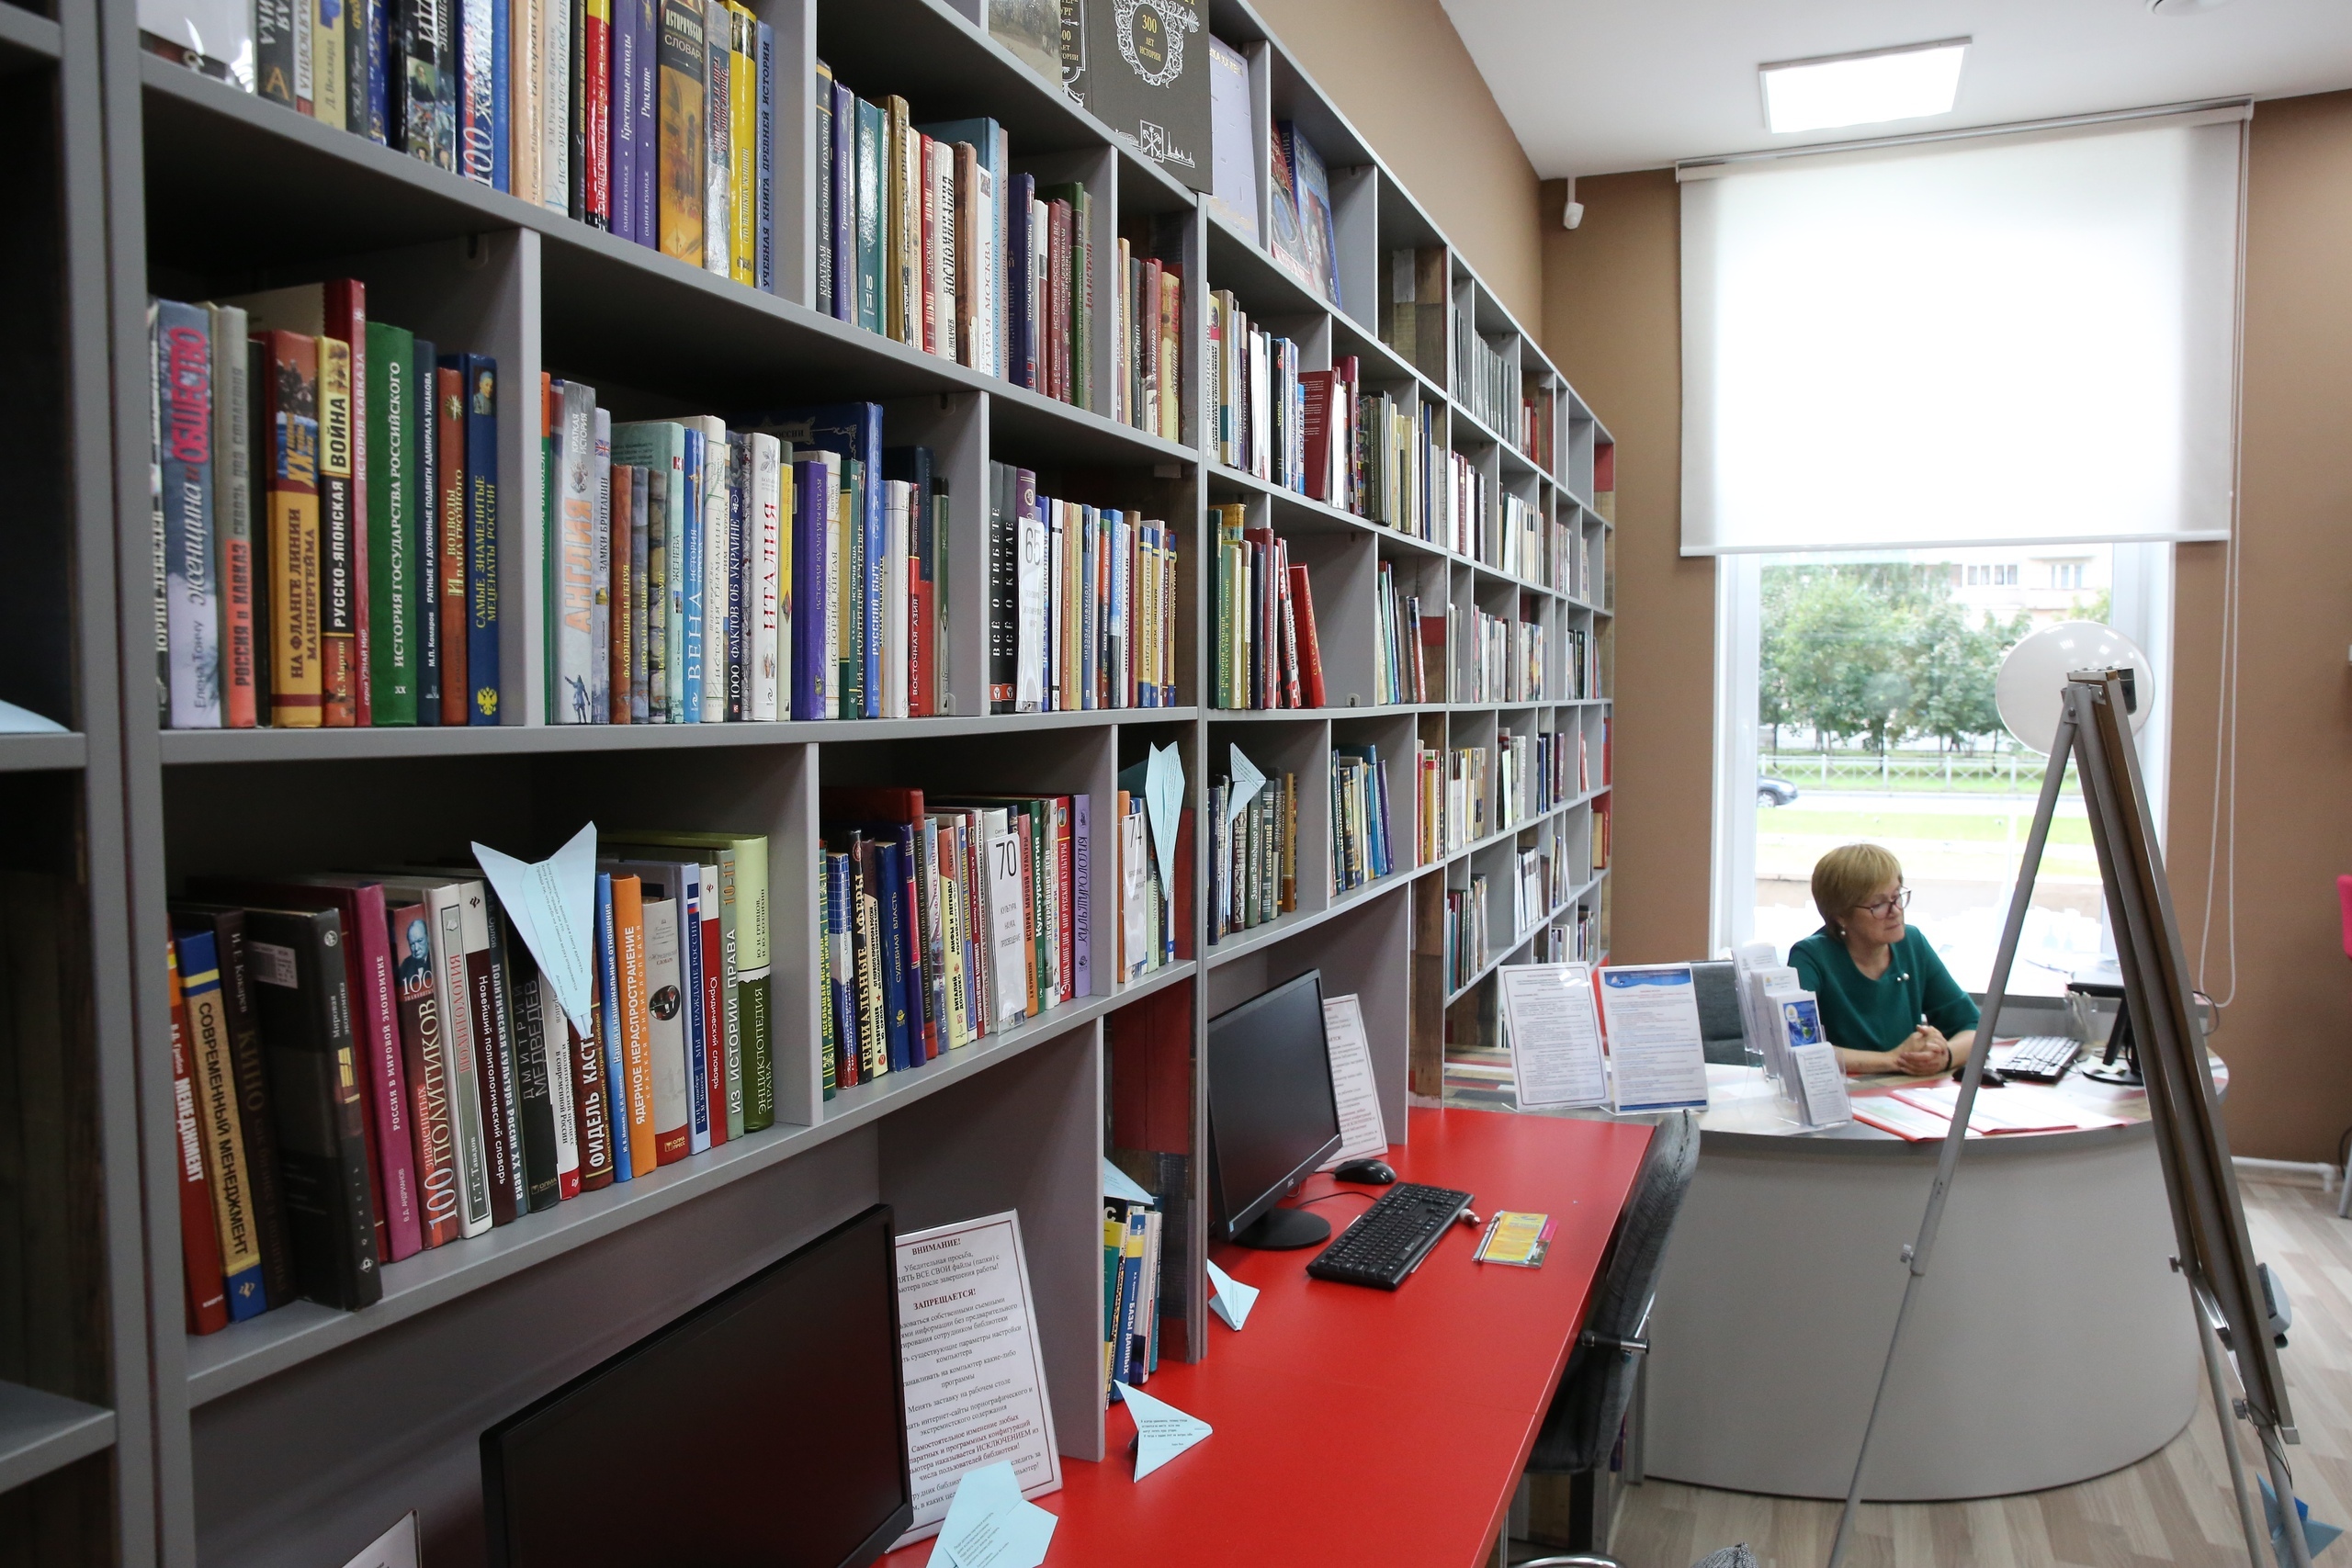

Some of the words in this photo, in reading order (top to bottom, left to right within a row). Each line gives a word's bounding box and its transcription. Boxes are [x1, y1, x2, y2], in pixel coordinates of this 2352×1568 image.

[1142, 14, 1157, 34] 300
[1146, 37, 1154, 47] ЛЕТ
[622, 34, 632, 76] походы
[1140, 46, 1161, 62] ИСТОРИИ
[620, 80, 632, 141] Крестовые
[640, 68, 651, 118] Римляне
[943, 175, 955, 297] ВОСПОМИНАНИЯ
[170, 327, 209, 464] ОБЩЕСТВО
[356, 353, 365, 415] КАВКАЗА
[424, 372, 433, 416] УШАКОВА
[327, 398, 347, 468] ВОЙНА
[388, 362, 402, 478] РОССИЙСКОГО
[424, 419, 434, 466] АДМИРАЛА
[571, 412, 580, 454] КРАТКАЯ
[579, 412, 588, 455] ИСТОРИЯ
[356, 420, 366, 480] ИСТОРИЯ
[424, 468, 434, 508] ПОДВИГИ
[485, 484, 496, 539] РОССИИ
[599, 477, 609, 533] БРИТАНИИ
[288, 508, 301, 572] ЛИНИИ
[390, 479, 403, 590] ГОСУДАРСТВА
[425, 510, 435, 558] ДУХОВНЫЕ
[447, 490, 457, 556] ВОЕВОДЫ
[474, 475, 486, 572] ЗНАМЕНИТЫЕ
[729, 518, 741, 578] УКРАИНЕ
[991, 506, 1001, 586] ТИБЕТЕ
[232, 544, 249, 604] КАВКАЗ
[331, 481, 347, 627] РУССКО-ЯПОНСКАЯ
[447, 543, 464, 597] ИВАНА
[564, 496, 594, 635] АНГЛИЯ
[599, 536, 608, 572] ЗАМКИ
[672, 534, 681, 583] ЖЕНЕВА
[690, 529, 698, 582] ИСТОРИЯ
[763, 501, 778, 630] ИТАЛИЯ
[830, 550, 838, 594] КИТАЯ
[870, 561, 879, 592] БЫТ
[1005, 521, 1013, 586] КИТАЕ
[302, 528, 318, 660] МАННЕРГЕЙМА
[426, 570, 435, 604] РАТНЫЕ
[476, 578, 487, 628] САМЫЕ
[487, 545, 498, 621] МЕЦЕНАТЫ
[622, 564, 630, 597] ГЕНУЯ
[729, 584, 740, 602] ОБ
[991, 599, 1001, 607] О
[1005, 599, 1013, 607] О
[289, 579, 303, 647] ФЛАНГЕ
[391, 593, 404, 667] ИСТОРИЯ
[427, 612, 435, 649] Комаров
[687, 590, 702, 682] ВЕНА
[729, 605, 741, 659] ФАКТОВ
[870, 599, 879, 656] РУССКИЙ
[991, 620, 1001, 657] ВСЁ
[1004, 621, 1013, 656] ВСЁ
[233, 626, 251, 687] РОССИЯ
[289, 651, 303, 679] НА
[336, 641, 346, 684] Мартин
[427, 650, 435, 667] М.П.
[623, 613, 631, 678] ФЛОРЕНЦИЯ
[730, 664, 741, 700] 1000
[723, 861, 736, 906] 10-11
[995, 839, 1017, 880] 70
[1059, 842, 1069, 879] КУЛЬТУРЫ
[854, 874, 865, 935] АФЕРЫ
[891, 892, 899, 929] ВЛАСТЬ
[1035, 837, 1044, 937] Культурология
[1059, 881, 1069, 911] РУССКОЙ
[1078, 836, 1088, 946] КУЛЬТУРОЛОГИЯ
[1250, 874, 1259, 899] Закат
[604, 904, 615, 955] отношения
[690, 920, 699, 965] РОССИИ
[1060, 913, 1069, 929] МИР
[726, 929, 738, 988] ПРАВА
[893, 934, 902, 983] СУДЕБНАЯ
[376, 955, 392, 1021] ЭКОНОМИКЕ
[448, 954, 472, 1072] ПОЛИТОЛОГИЯ
[478, 976, 493, 1035] Новейший
[491, 964, 509, 1045] Политическая
[605, 956, 619, 1025] национальные
[624, 926, 643, 1065] НЕРАСПРОСТРАНЕНИЕ
[691, 967, 701, 1029] ГРАЖДАНЕ
[709, 976, 719, 1048] Юридический
[857, 946, 874, 1071] ГЕНИАЛЬНЫЕ
[381, 1024, 397, 1077] МИРОВОЙ
[525, 979, 548, 1097] МЕДВЕДЕВ
[611, 1033, 622, 1064] Нации
[693, 1039, 702, 1057] МЫ
[727, 997, 741, 1082] ИСТОРИИ
[753, 987, 769, 1115] ЭНЦИКЛОПЕДИЯ
[417, 998, 452, 1165] ПОЛИТИКОВ
[483, 1038, 503, 1137] политологический
[498, 1048, 516, 1106] культура
[631, 1066, 647, 1125] ЯДЕРНОЕ
[711, 1049, 720, 1089] словарь
[389, 1089, 401, 1131] РОССИЯ
[729, 1089, 741, 1114] ИЗ
[175, 1077, 204, 1182] МЕНЕДЖМЕНТ
[196, 1001, 232, 1136] СОВРЕМЕННЫЙ
[219, 1139, 248, 1257] МЕНЕДЖМЕНТ
[417, 1086, 435, 1171] знаменитых
[505, 1109, 518, 1149] России
[586, 1092, 606, 1168] ФИДЕЛЬ
[493, 1140, 507, 1185] словарь
[514, 1172, 525, 1201] века
[423, 1166, 459, 1230] 100
[904, 1258, 946, 1272] Убедительная
[947, 1251, 974, 1264] просьба,
[912, 1238, 961, 1256] ВНИМАНИЕ!
[913, 1289, 976, 1311] ЗАПРЕЩАЕТСЯ!
[922, 1280, 938, 1289] после
[940, 1270, 975, 1283] завершения
[977, 1263, 999, 1276] работы!
[908, 1403, 933, 1414] Менять
[933, 1394, 959, 1406] заставку
[968, 1382, 993, 1396] рабочем
[995, 1378, 1011, 1388] столе
[911, 1432, 965, 1453] Самостоятельное
[967, 1422, 998, 1437] изменение
[1000, 1415, 1019, 1427] любых
[977, 1429, 1031, 1452] ИСКЛЮЧЕНИЕМ
[919, 1471, 937, 1481] числа
[939, 1456, 982, 1476] пользователей
[983, 1442, 1021, 1461] библиотеки!
